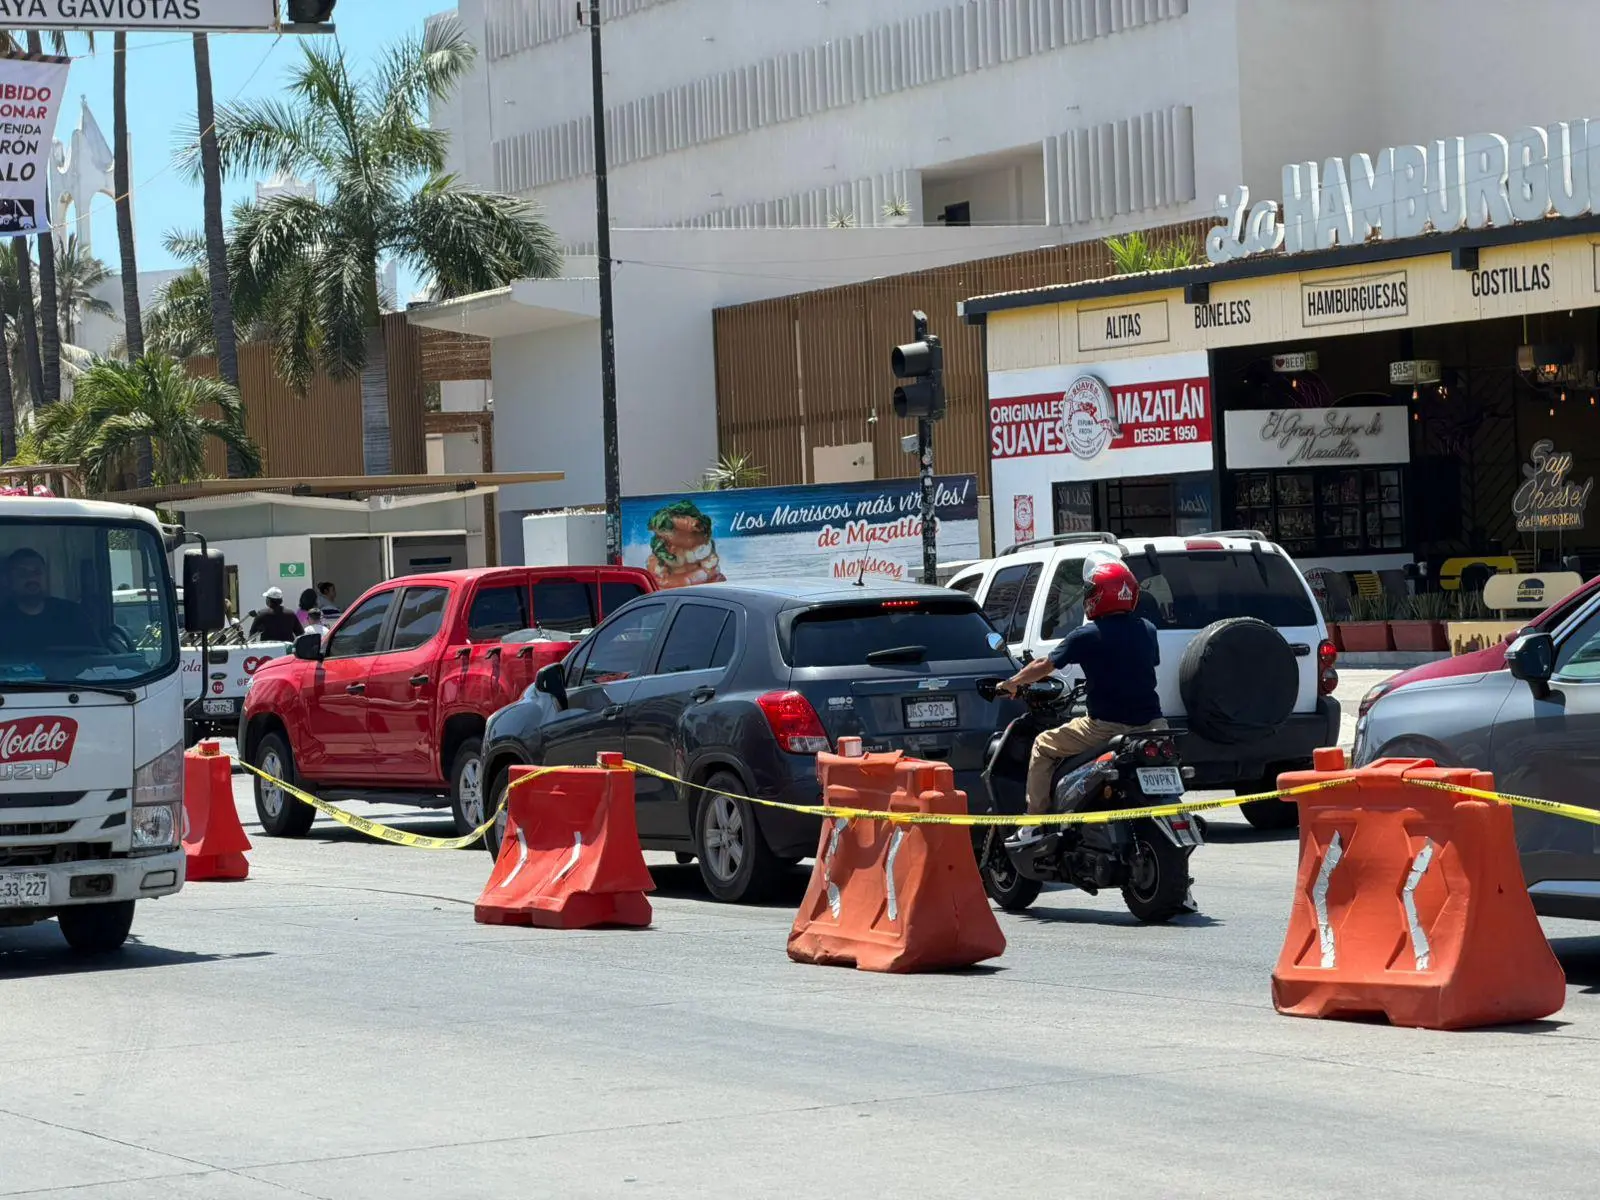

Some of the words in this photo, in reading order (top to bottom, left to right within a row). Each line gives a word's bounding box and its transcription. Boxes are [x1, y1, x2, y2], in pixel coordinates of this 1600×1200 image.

[57, 0, 200, 19] GAVIOTAS
[0, 162, 35, 181] LO
[1281, 117, 1600, 256] HAMBURGU
[1471, 263, 1551, 297] COSTILLAS
[1307, 281, 1407, 316] HAMBURGUESAS
[1106, 313, 1141, 340] ALITAS
[1194, 300, 1251, 329] BONELESS
[990, 400, 1064, 424] ORIGINALES
[1116, 382, 1205, 425] MAZATLÁN
[992, 419, 1068, 457] SUAVES
[1134, 426, 1171, 443] DESDE
[1173, 424, 1198, 441] 1950
[1532, 443, 1570, 488] Say
[730, 511, 766, 532] ¡Los
[770, 501, 851, 526] Mariscos
[855, 493, 895, 516] más
[900, 480, 970, 511] virles!
[817, 528, 841, 547] de
[833, 557, 903, 578] Mariscos
